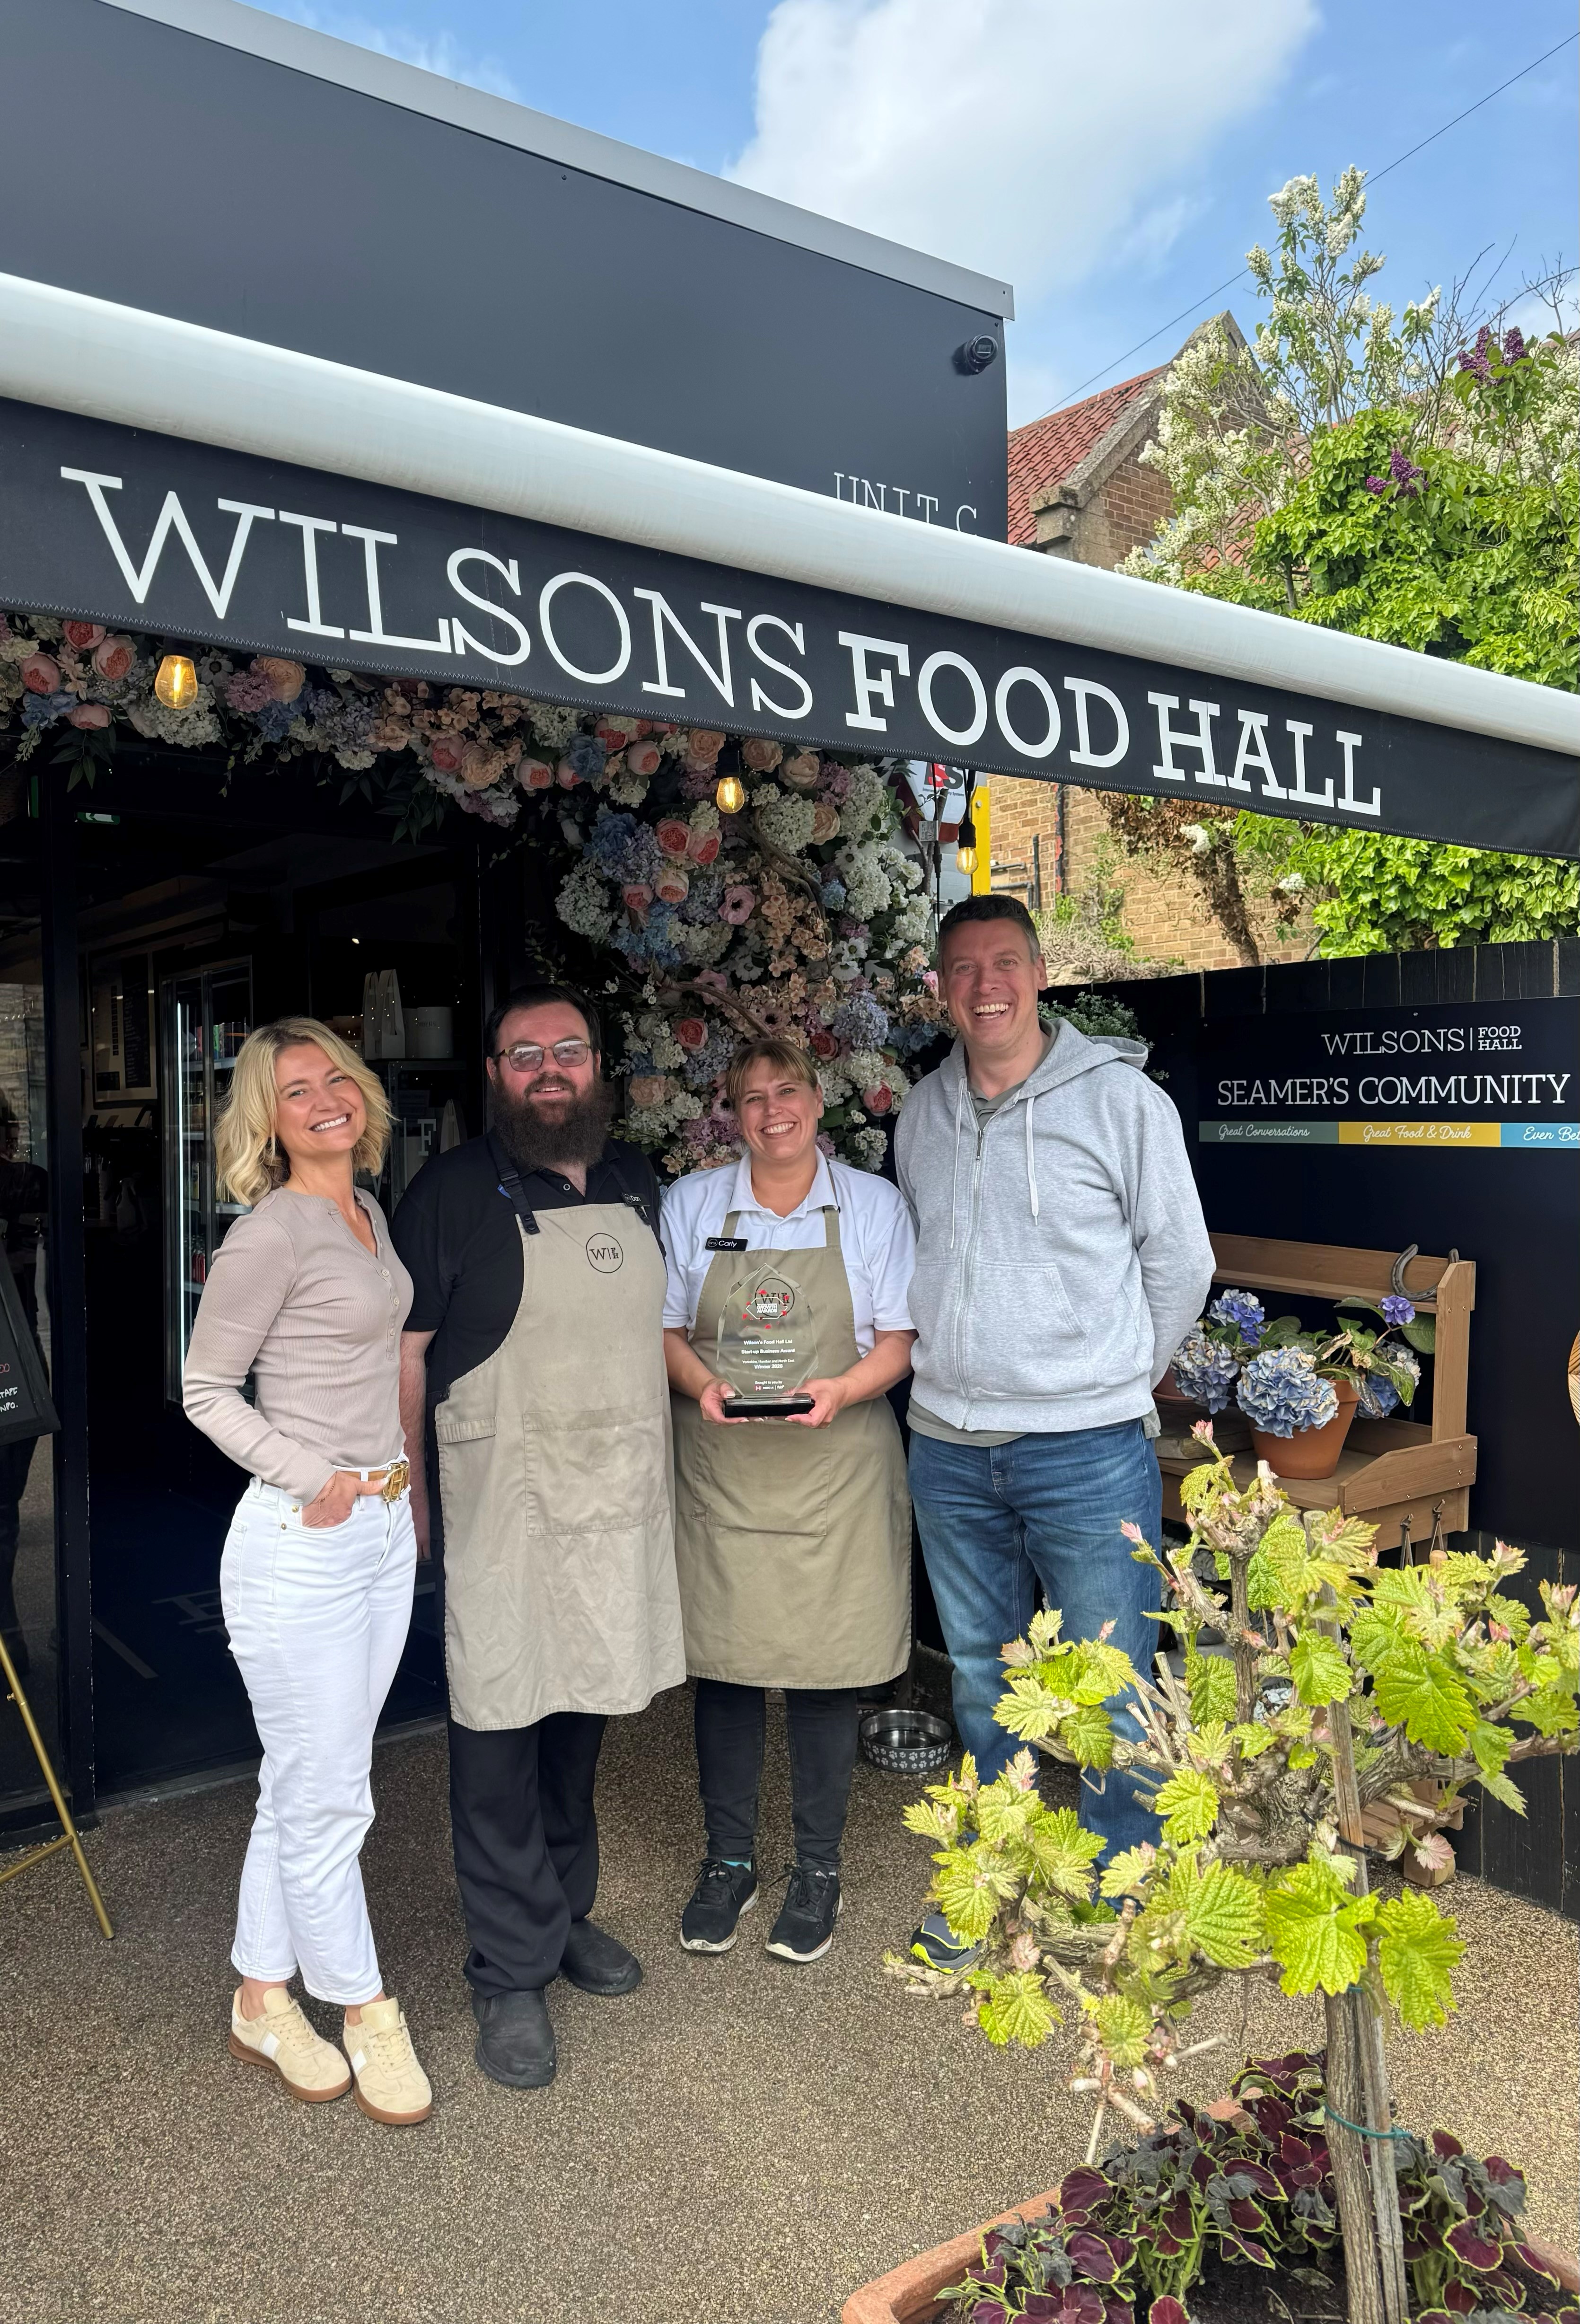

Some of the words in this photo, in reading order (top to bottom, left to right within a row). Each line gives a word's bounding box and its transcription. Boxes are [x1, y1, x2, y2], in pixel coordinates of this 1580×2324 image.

[956, 504, 977, 537] C
[60, 467, 813, 719] WILSONS
[839, 631, 1129, 768] FOOD
[1148, 691, 1381, 817] HALL
[1321, 1028, 1465, 1055] WILSONS
[1478, 1026, 1521, 1038] FOOD
[1478, 1039, 1522, 1050] HALL
[1217, 1077, 1349, 1105] SEAMER'S
[1358, 1074, 1571, 1105] COMMUNITY
[1219, 1124, 1243, 1137] Great
[1246, 1124, 1310, 1137] Conversations
[1363, 1125, 1391, 1140] Great
[1398, 1126, 1425, 1138] Food
[1427, 1126, 1438, 1138] &
[1440, 1126, 1472, 1139] Drink
[1523, 1126, 1554, 1141] Even
